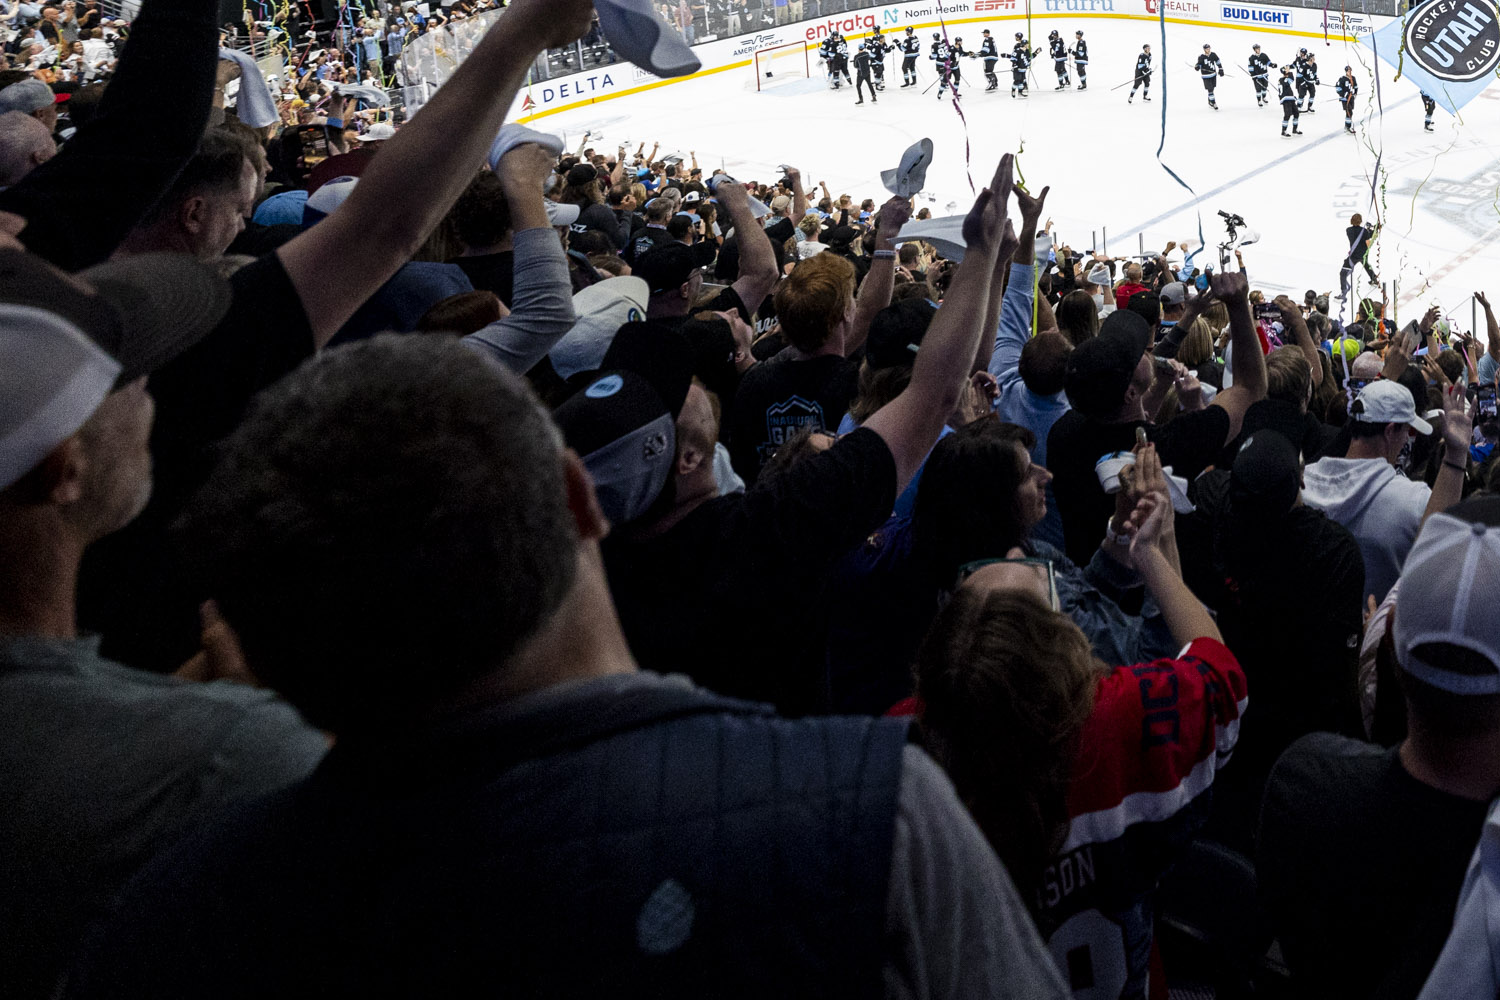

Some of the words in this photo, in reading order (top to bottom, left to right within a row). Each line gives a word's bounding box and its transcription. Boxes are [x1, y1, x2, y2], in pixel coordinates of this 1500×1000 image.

[905, 7, 932, 19] Nomi
[934, 2, 970, 16] Health
[1163, 0, 1200, 13] HEALTH
[1223, 6, 1249, 21] BUD
[1251, 9, 1291, 25] LIGHT
[1415, 0, 1457, 41] HOCKEY
[805, 13, 876, 42] entrata
[1351, 25, 1374, 34] FIRST
[1422, 2, 1493, 68] UTAH
[1466, 39, 1496, 71] CLUB
[543, 73, 615, 104] DELTA
